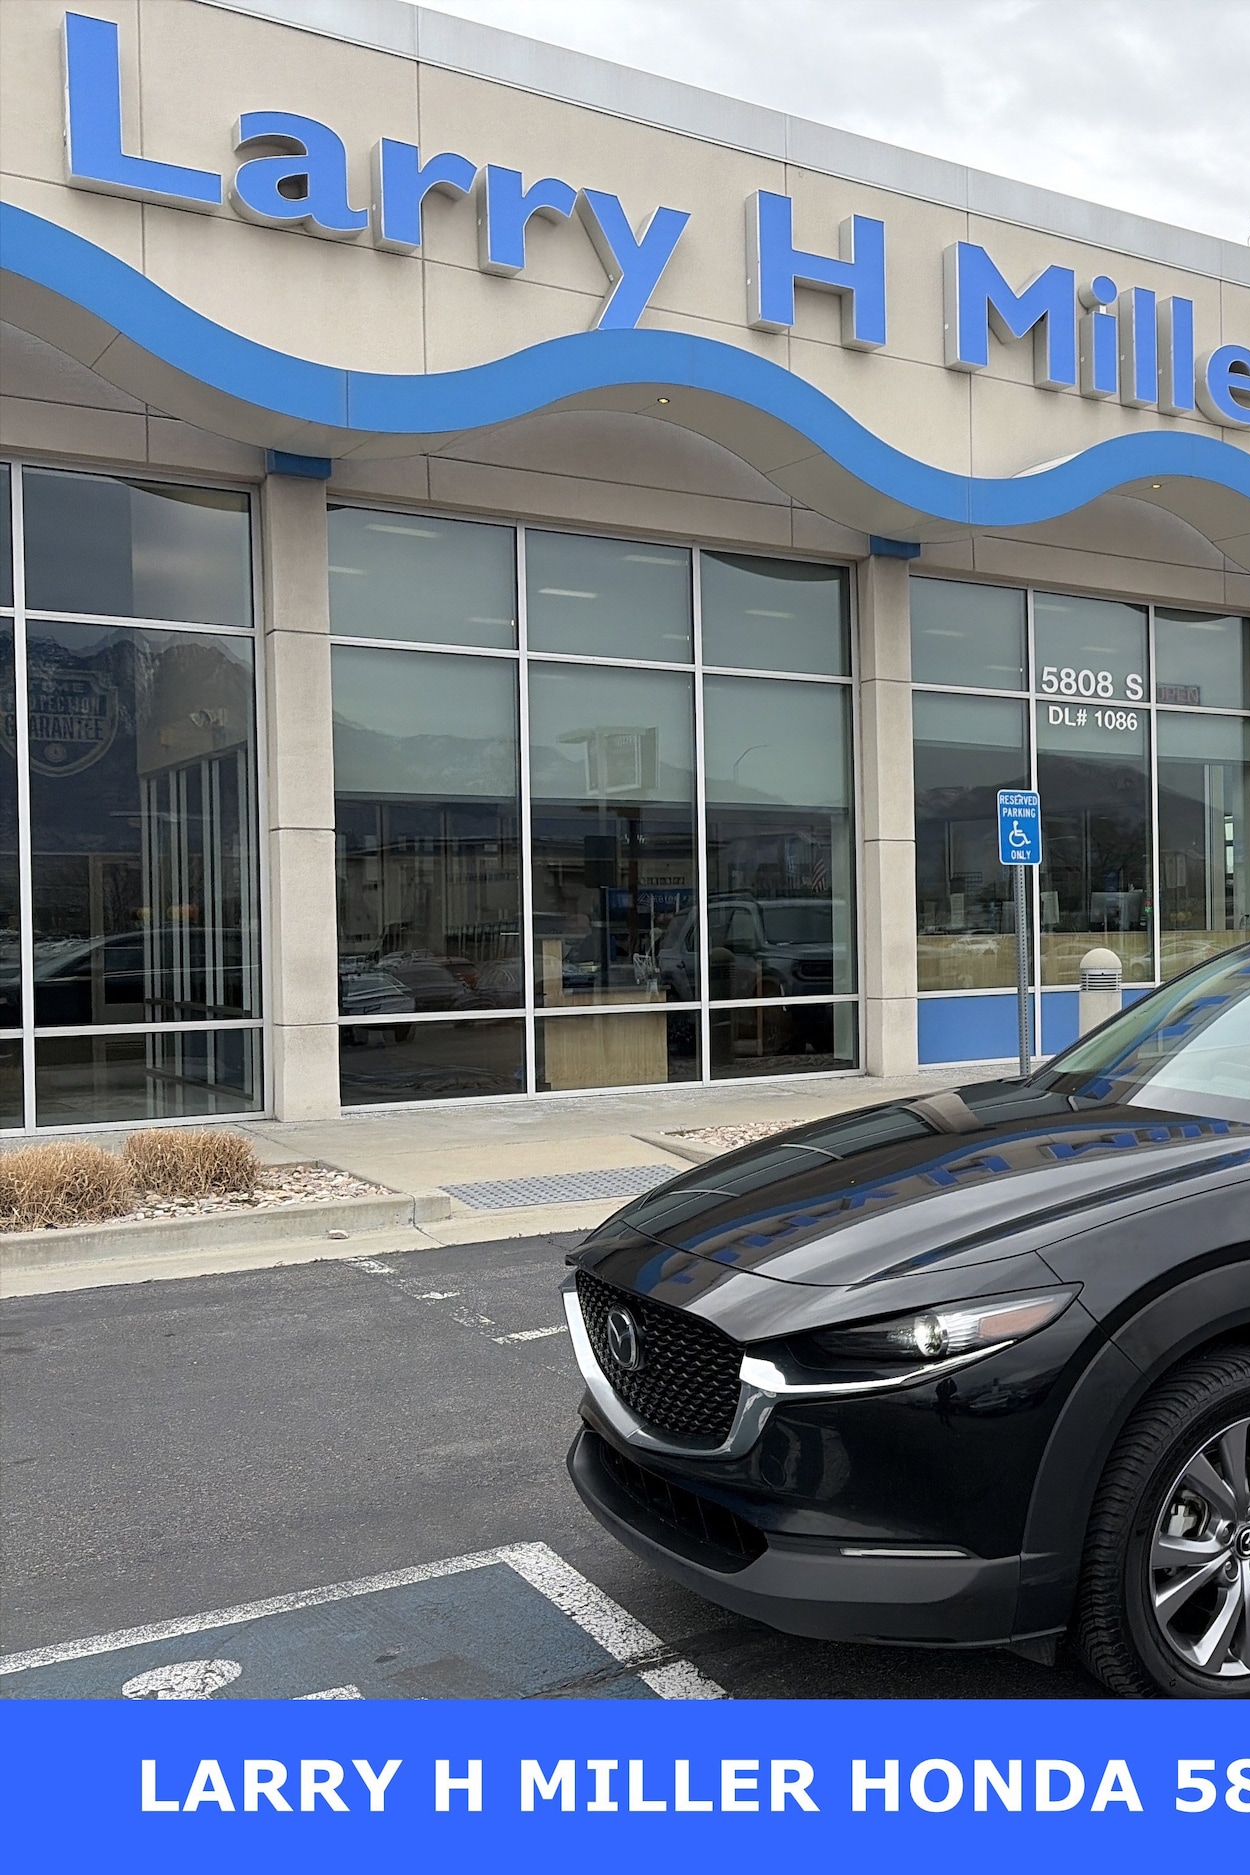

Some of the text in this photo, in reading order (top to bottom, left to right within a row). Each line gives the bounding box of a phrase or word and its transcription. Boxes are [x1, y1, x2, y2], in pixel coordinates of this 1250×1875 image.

[62, 11, 692, 331] Larry
[747, 189, 886, 350] H
[1041, 666, 1144, 701] 5808 S
[5, 714, 103, 740] GARANTEE
[1048, 705, 1138, 731] DL# 1086
[999, 794, 1038, 806] RESERVED
[1002, 807, 1036, 818] PARKING
[1011, 850, 1031, 860] ONLY
